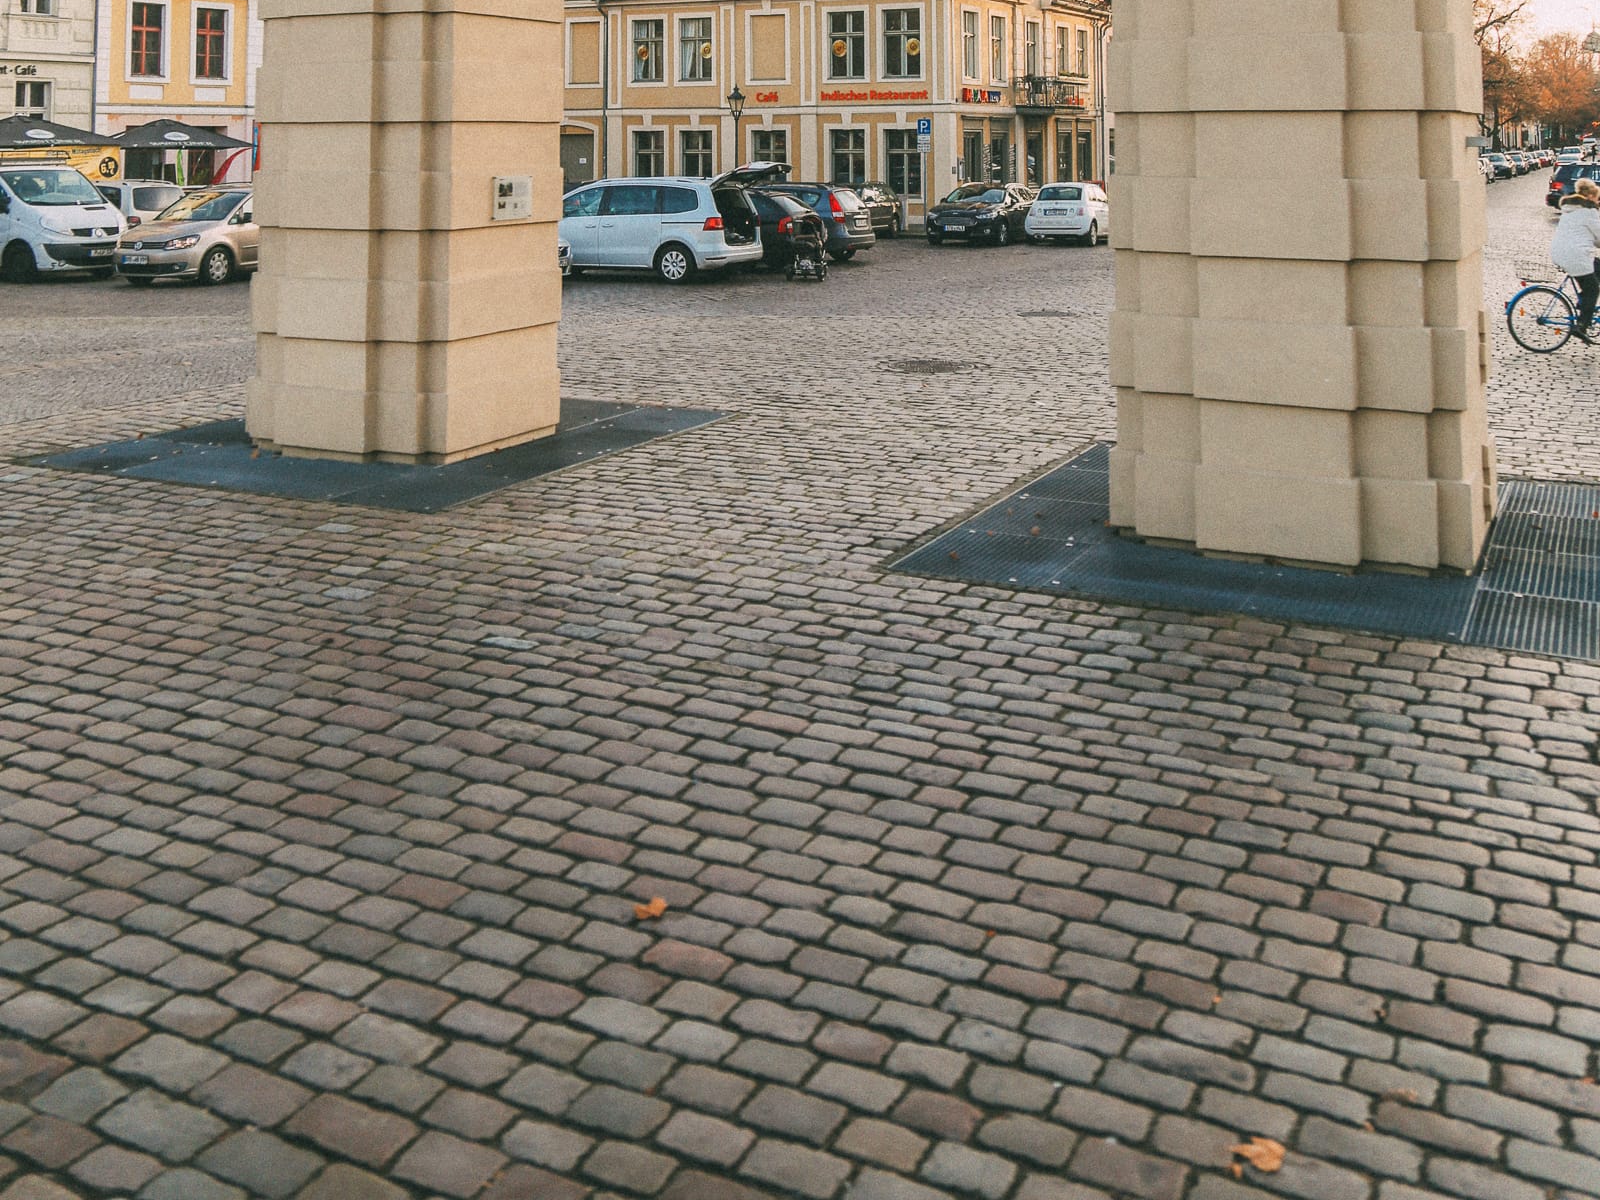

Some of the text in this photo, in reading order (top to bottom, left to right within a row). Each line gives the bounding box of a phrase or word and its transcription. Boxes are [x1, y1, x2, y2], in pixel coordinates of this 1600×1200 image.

[15, 64, 37, 76] Café
[755, 91, 779, 103] Café
[820, 89, 929, 102] Indisches Restaurant
[920, 120, 929, 133] P
